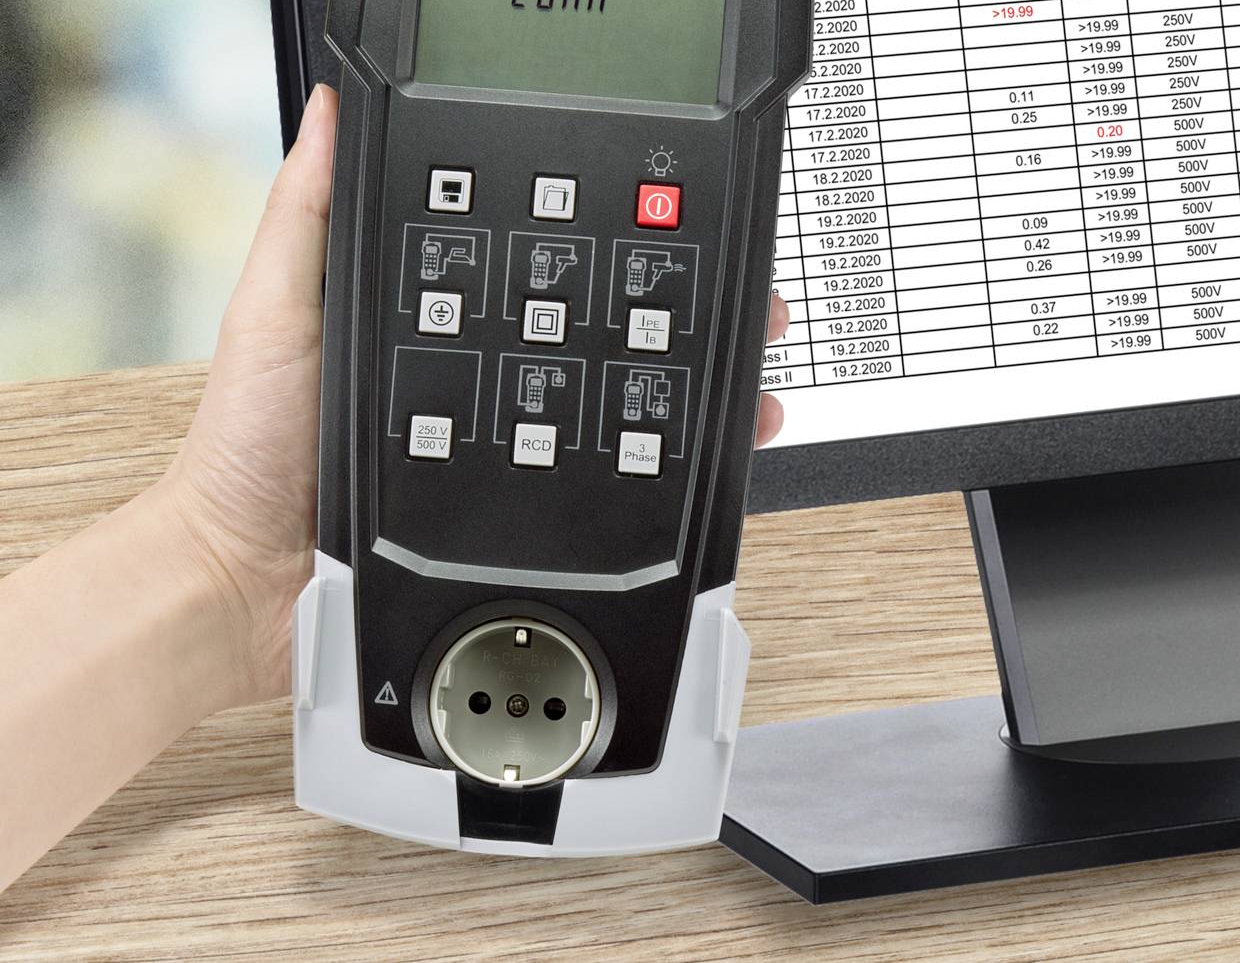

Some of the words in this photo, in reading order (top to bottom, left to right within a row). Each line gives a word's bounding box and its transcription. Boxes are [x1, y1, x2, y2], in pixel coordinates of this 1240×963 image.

[992, 6, 1033, 19] >19.99
[1079, 20, 1118, 32] >19.99
[1163, 14, 1192, 26] 250V
[1010, 91, 1033, 103] 0.11
[809, 127, 867, 141] 17.2.2020
[814, 169, 872, 184] 18.2.2020
[1031, 302, 1055, 314] 0.37
[828, 319, 887, 334] 19.2.2020
[1033, 323, 1058, 335] 0.22
[1196, 327, 1225, 340] 500V
[417, 425, 437, 436] 250
[439, 426, 448, 437] V
[416, 440, 436, 450] 500
[438, 440, 447, 451] V
[521, 439, 552, 452] RCD
[639, 444, 645, 453] 3
[624, 452, 657, 463] Phase
